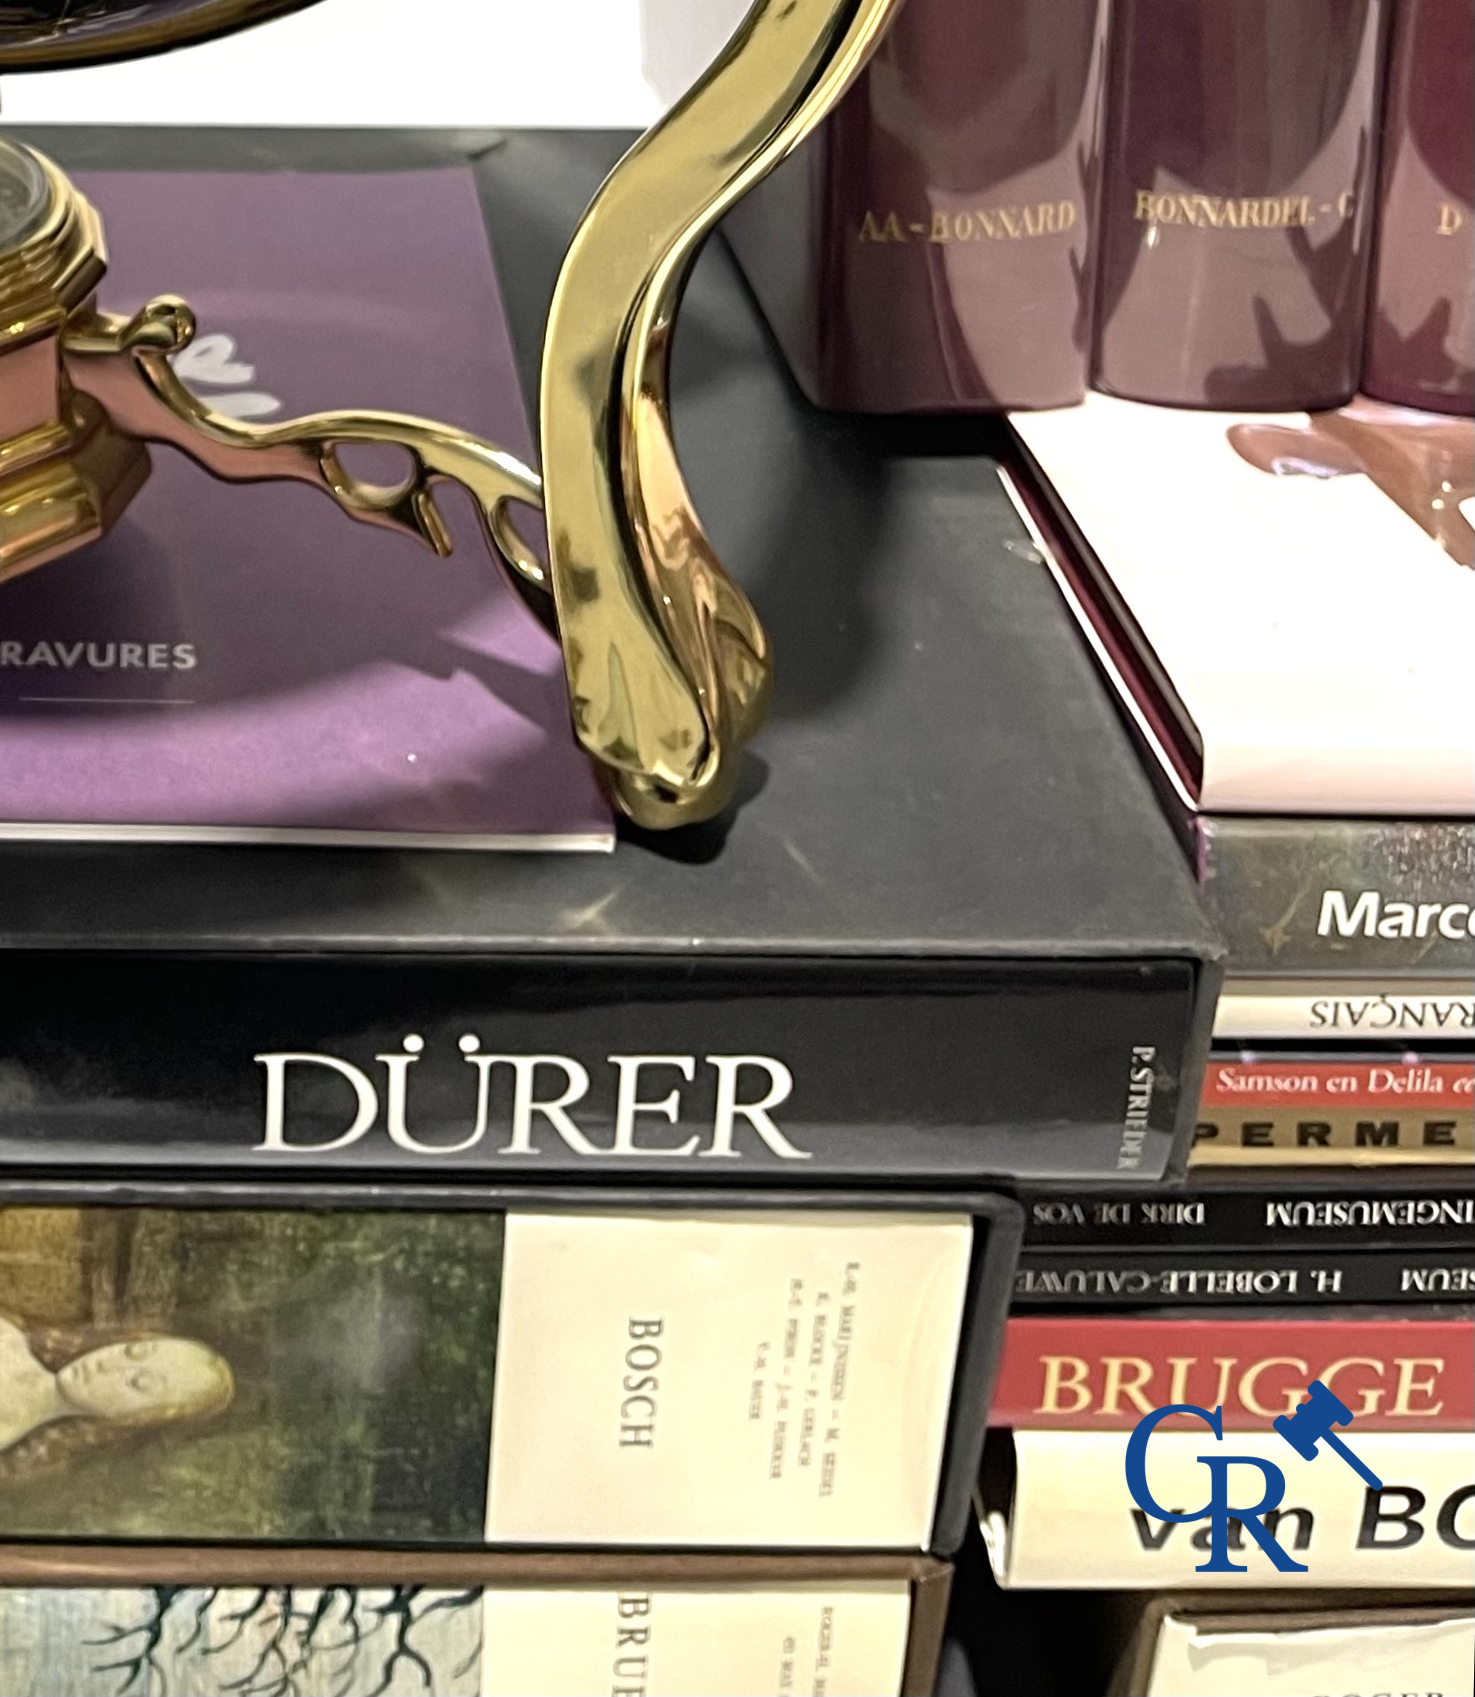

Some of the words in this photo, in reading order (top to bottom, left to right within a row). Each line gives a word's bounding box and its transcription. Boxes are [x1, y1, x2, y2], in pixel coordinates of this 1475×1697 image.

[251, 1032, 813, 1161] DÜRER
[1216, 1068, 1319, 1094] Samson
[1326, 1074, 1358, 1094] en
[1368, 1067, 1444, 1094] Delila
[1309, 1268, 1343, 1294] H.
[617, 1314, 664, 1453] BOSCH
[1032, 1353, 1446, 1419] BRUGGE
